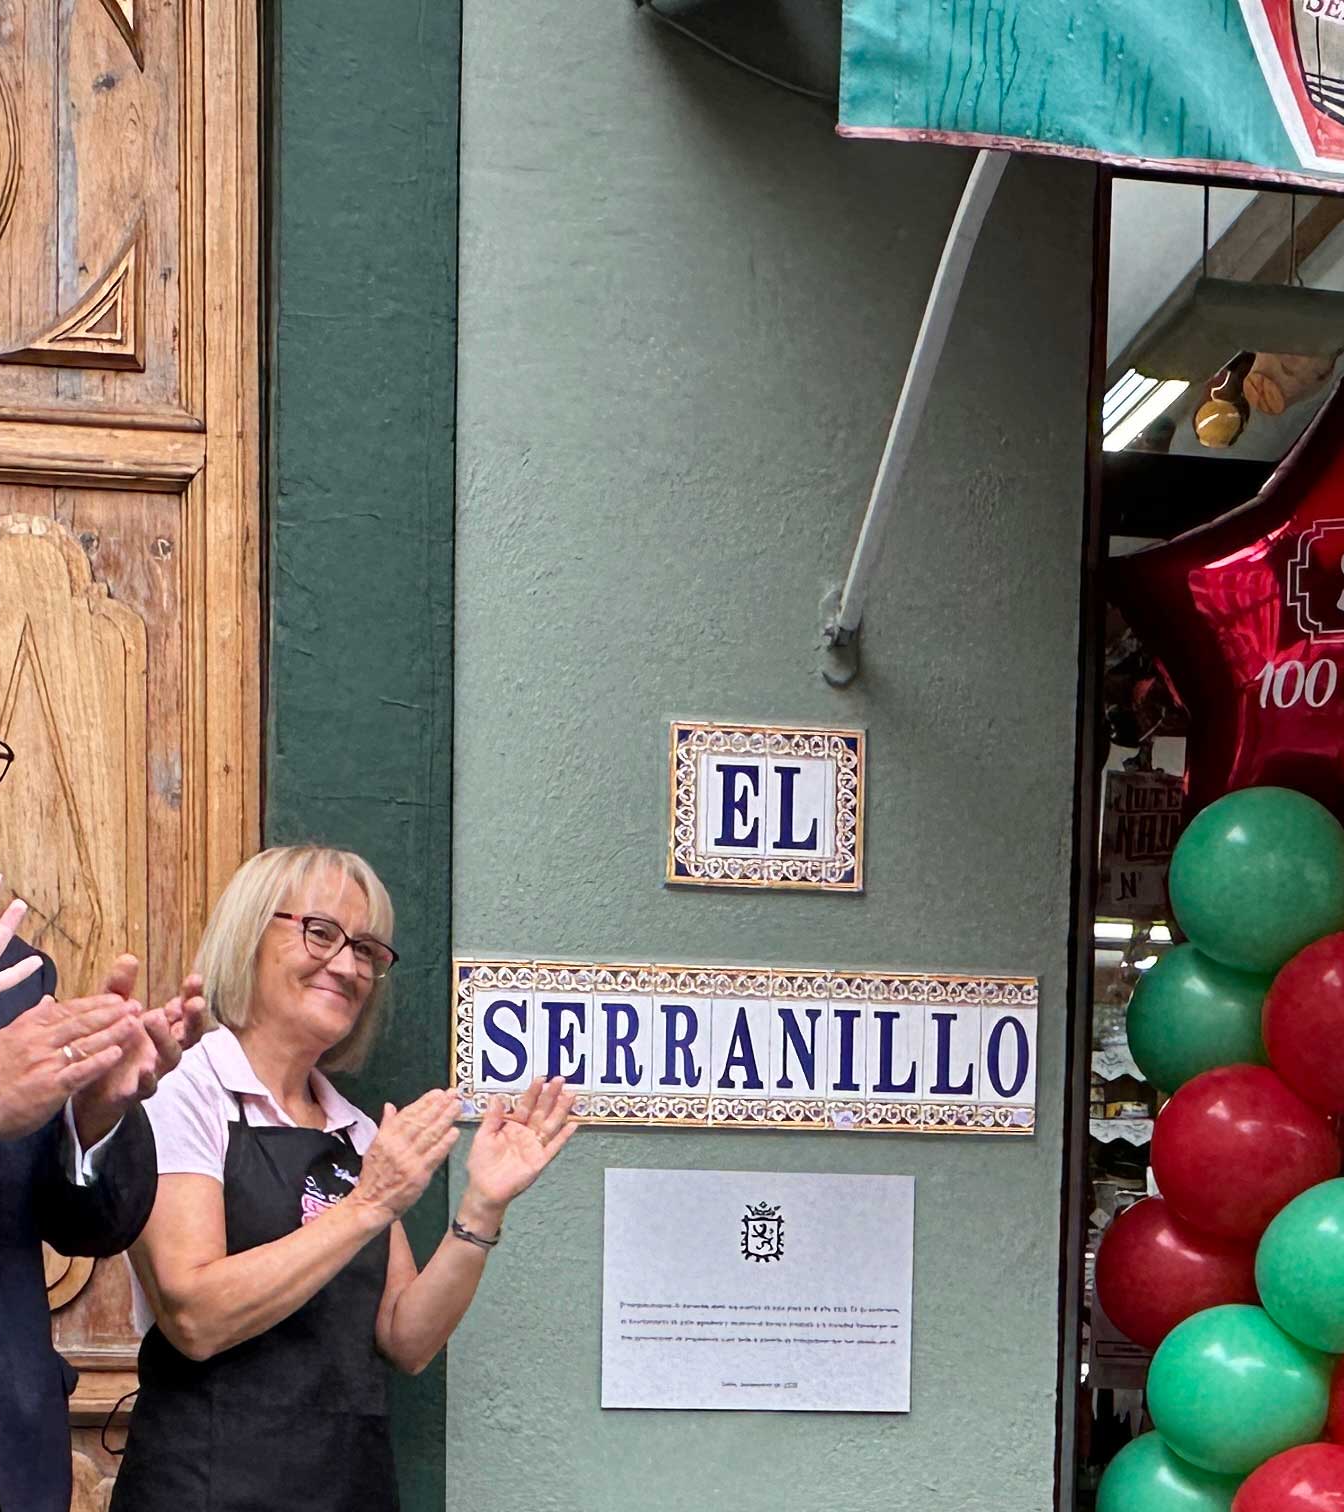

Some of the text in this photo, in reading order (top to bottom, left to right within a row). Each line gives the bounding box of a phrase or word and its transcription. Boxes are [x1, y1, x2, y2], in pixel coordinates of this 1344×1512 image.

[1256, 659, 1338, 709] 100
[714, 764, 818, 851] EL
[481, 1000, 1030, 1098] SERRANILLO
